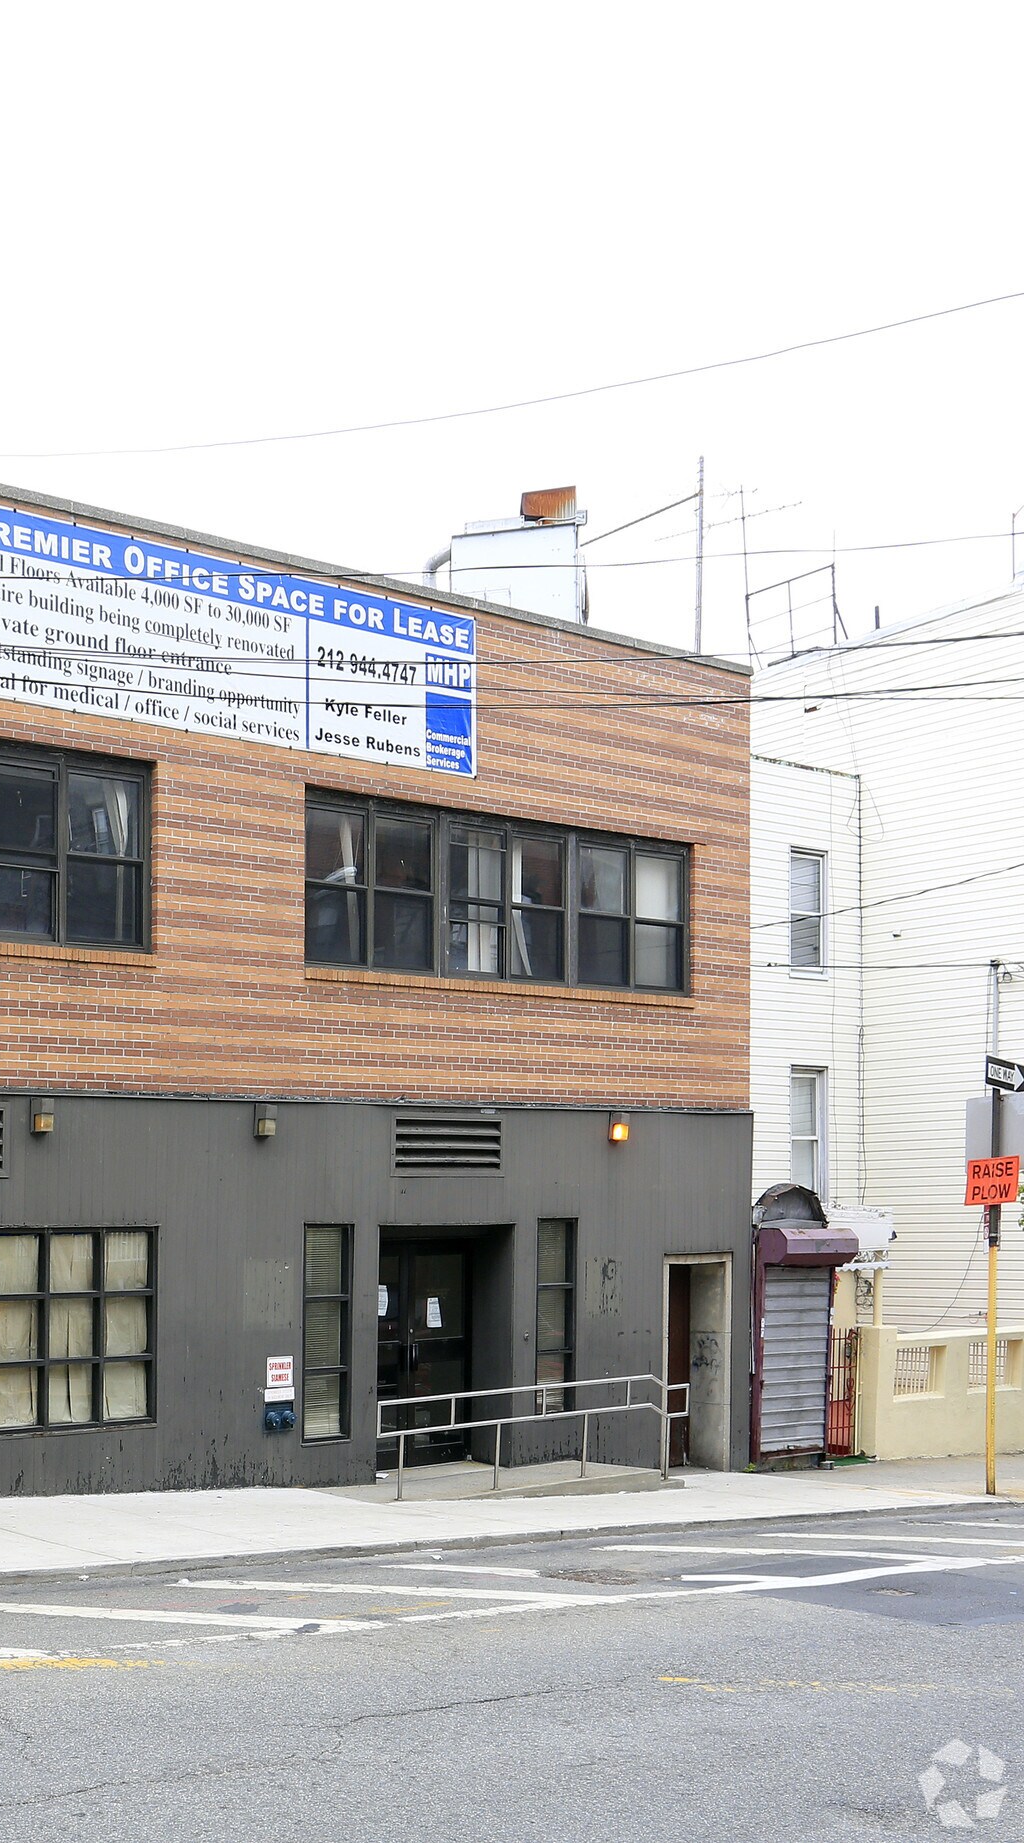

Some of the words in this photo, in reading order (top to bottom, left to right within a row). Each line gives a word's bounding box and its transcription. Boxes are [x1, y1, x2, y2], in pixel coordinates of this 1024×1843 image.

[10, 555, 61, 585] Floors
[65, 570, 137, 601] Available
[140, 586, 180, 610] 4,000
[184, 595, 204, 615] SF
[208, 602, 221, 619] to
[225, 604, 270, 629] 30,000
[273, 614, 292, 634] SF
[123, 545, 229, 596] OFFICE
[238, 573, 325, 617] SPACE
[333, 599, 385, 631] FOR
[393, 607, 470, 650] LEASE
[28, 588, 94, 625] building
[99, 604, 140, 634] being
[144, 619, 222, 650] completely
[227, 635, 295, 660] renovated
[44, 626, 109, 652] ground
[115, 636, 157, 660] floor
[161, 650, 232, 675] entrance
[317, 646, 344, 671] 212
[349, 653, 417, 686] 944.4747
[427, 655, 472, 688] MHP
[77, 659, 134, 687] signage
[148, 670, 215, 704] branding
[219, 689, 301, 719] opportunity
[22, 675, 48, 696] for
[53, 685, 119, 710] medical
[135, 697, 180, 720] office
[193, 711, 237, 730] social
[241, 720, 300, 741] services
[325, 697, 359, 717] Kyle
[364, 704, 408, 726] Feller
[315, 728, 360, 747] Jesse
[366, 736, 421, 757] Rubens
[426, 729, 471, 746] Commercial
[426, 743, 466, 759] Brokerage
[426, 755, 460, 770] Services
[989, 1065, 1002, 1080] ONE
[1002, 1068, 1015, 1082] WAY
[972, 1161, 1014, 1179] RAISE
[971, 1183, 1011, 1201] PLOW
